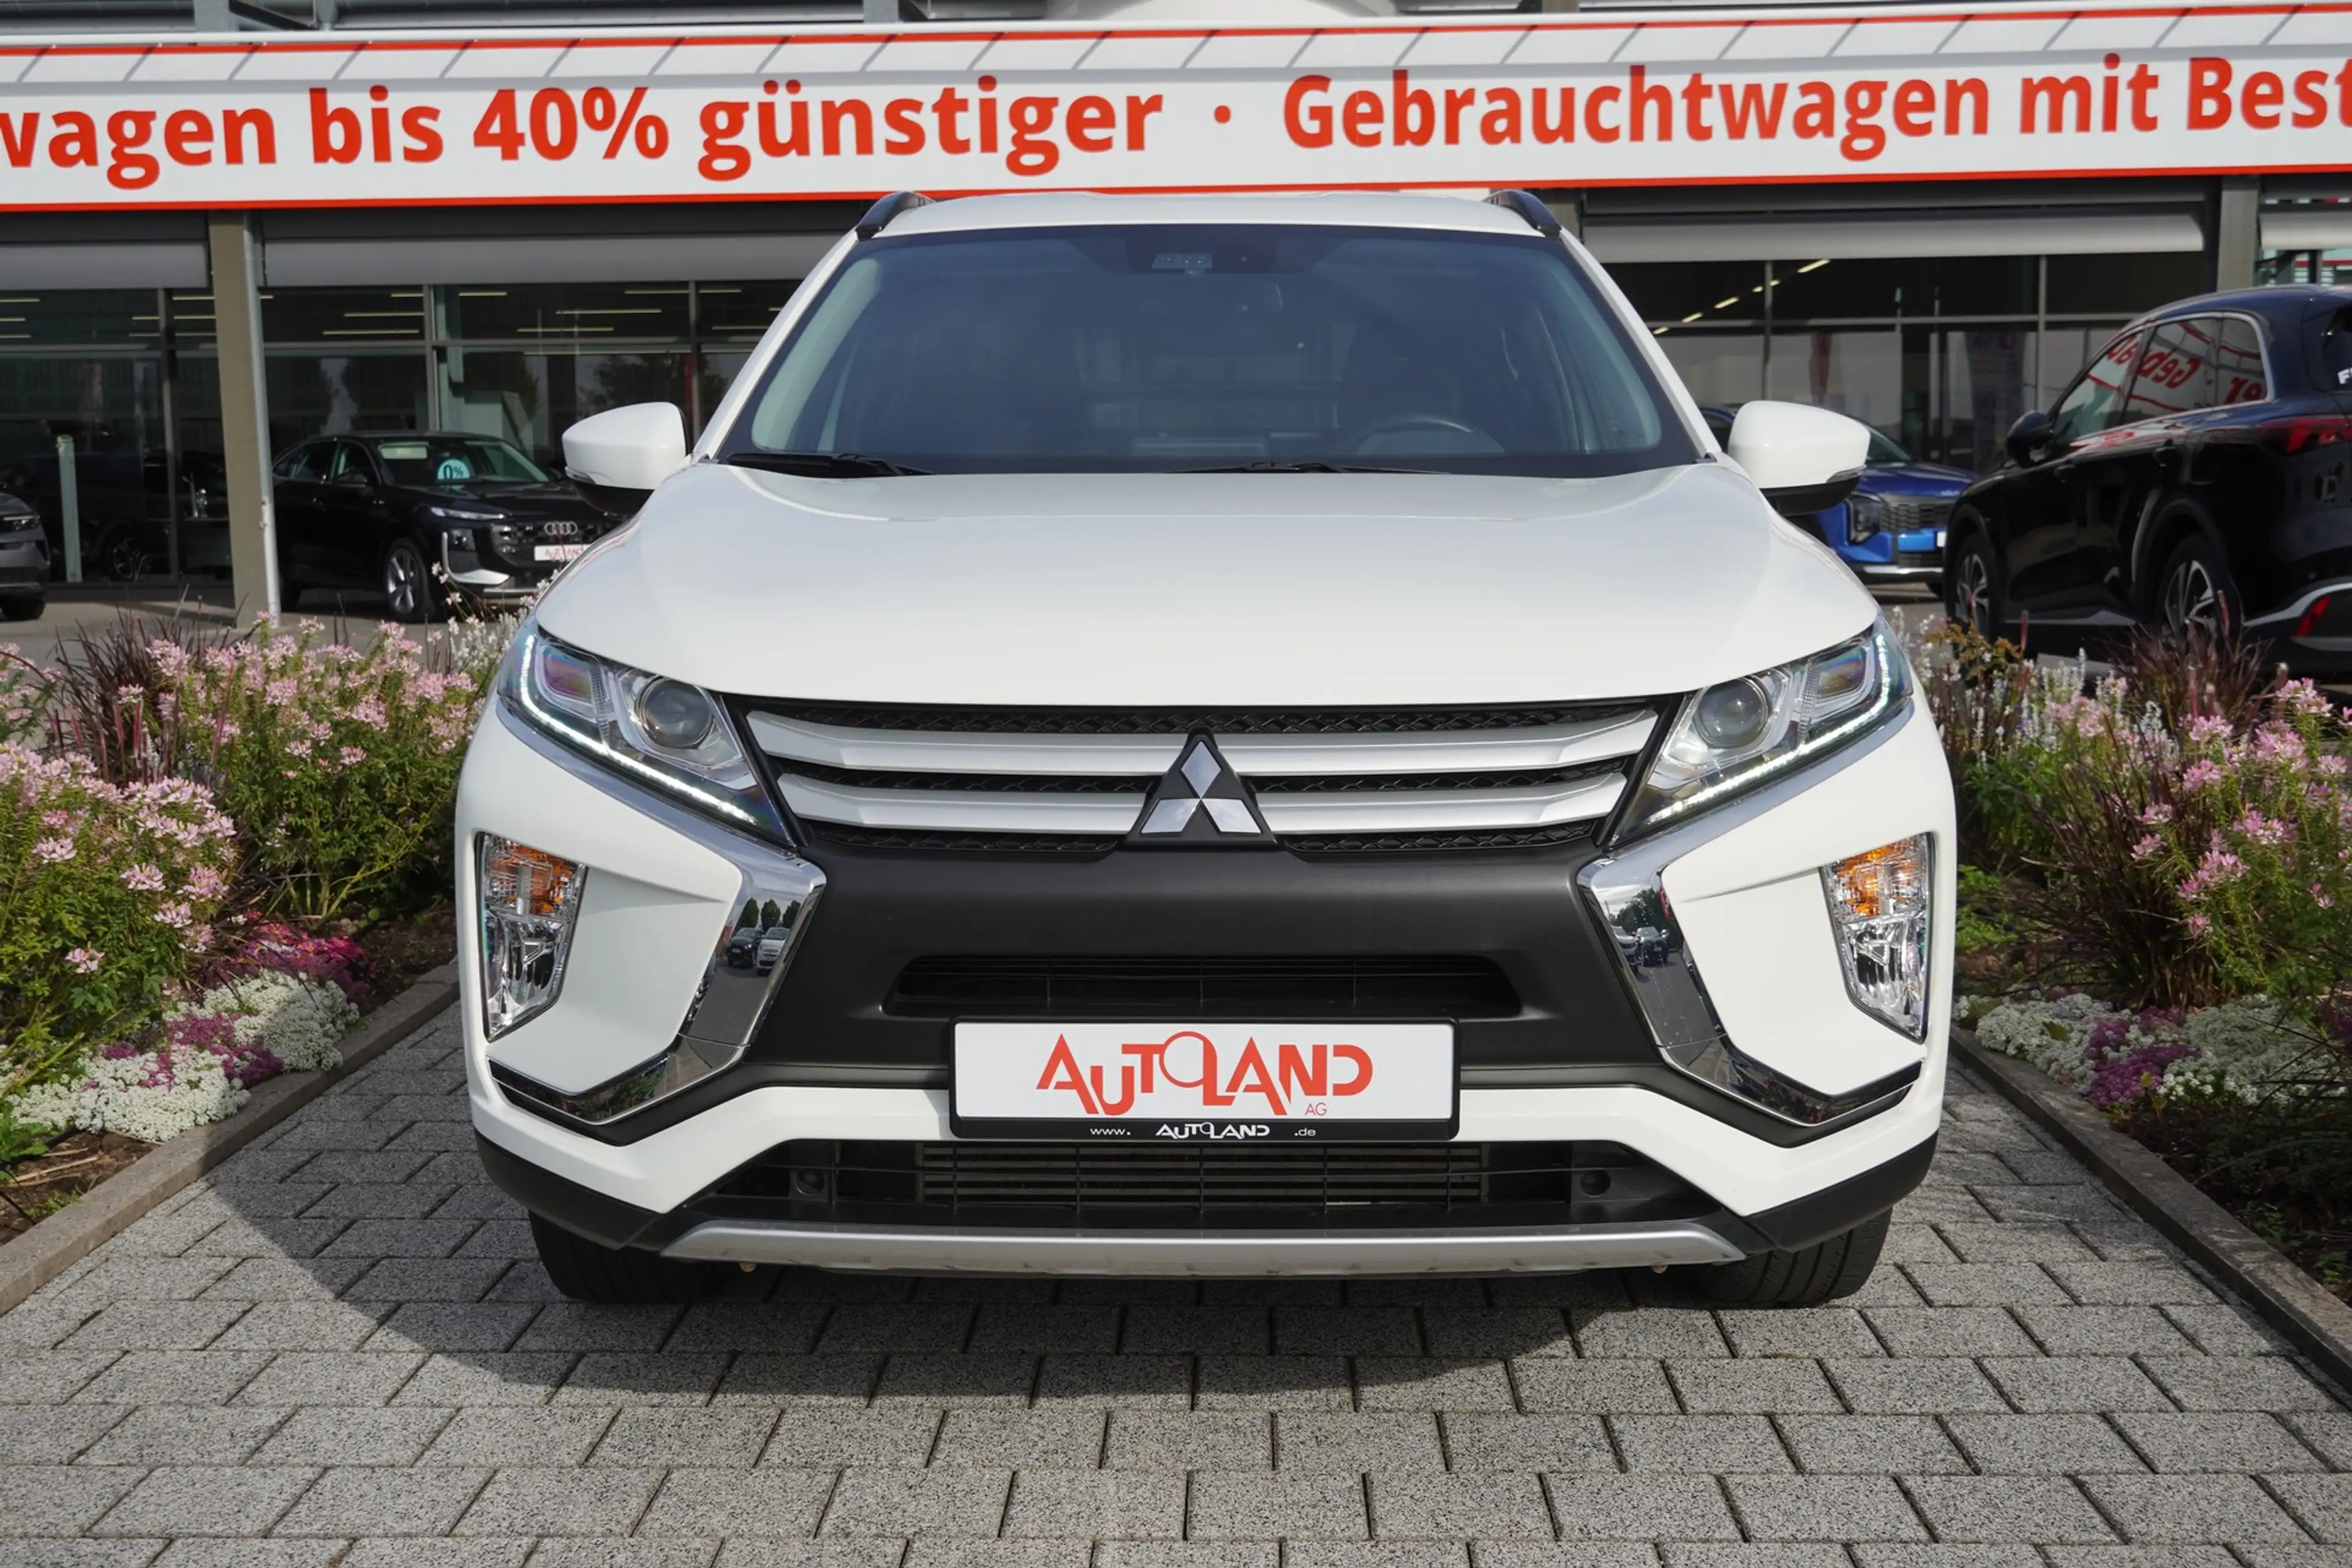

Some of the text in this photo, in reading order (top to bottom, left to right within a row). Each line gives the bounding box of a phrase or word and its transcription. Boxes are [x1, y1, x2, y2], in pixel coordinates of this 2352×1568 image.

[309, 85, 444, 164] bis
[473, 86, 669, 161] 40%
[698, 75, 1163, 182] günstiger
[1284, 65, 1989, 161] Gebrauchtwagen
[2020, 54, 2159, 134] mit
[2187, 57, 2352, 130] Best
[443, 464, 464, 480] 0%
[1036, 1031, 1373, 1116] AUTOLAND
[1305, 1102, 1327, 1116] AG
[1090, 1121, 1317, 1140] www. AUTOLAND .de
